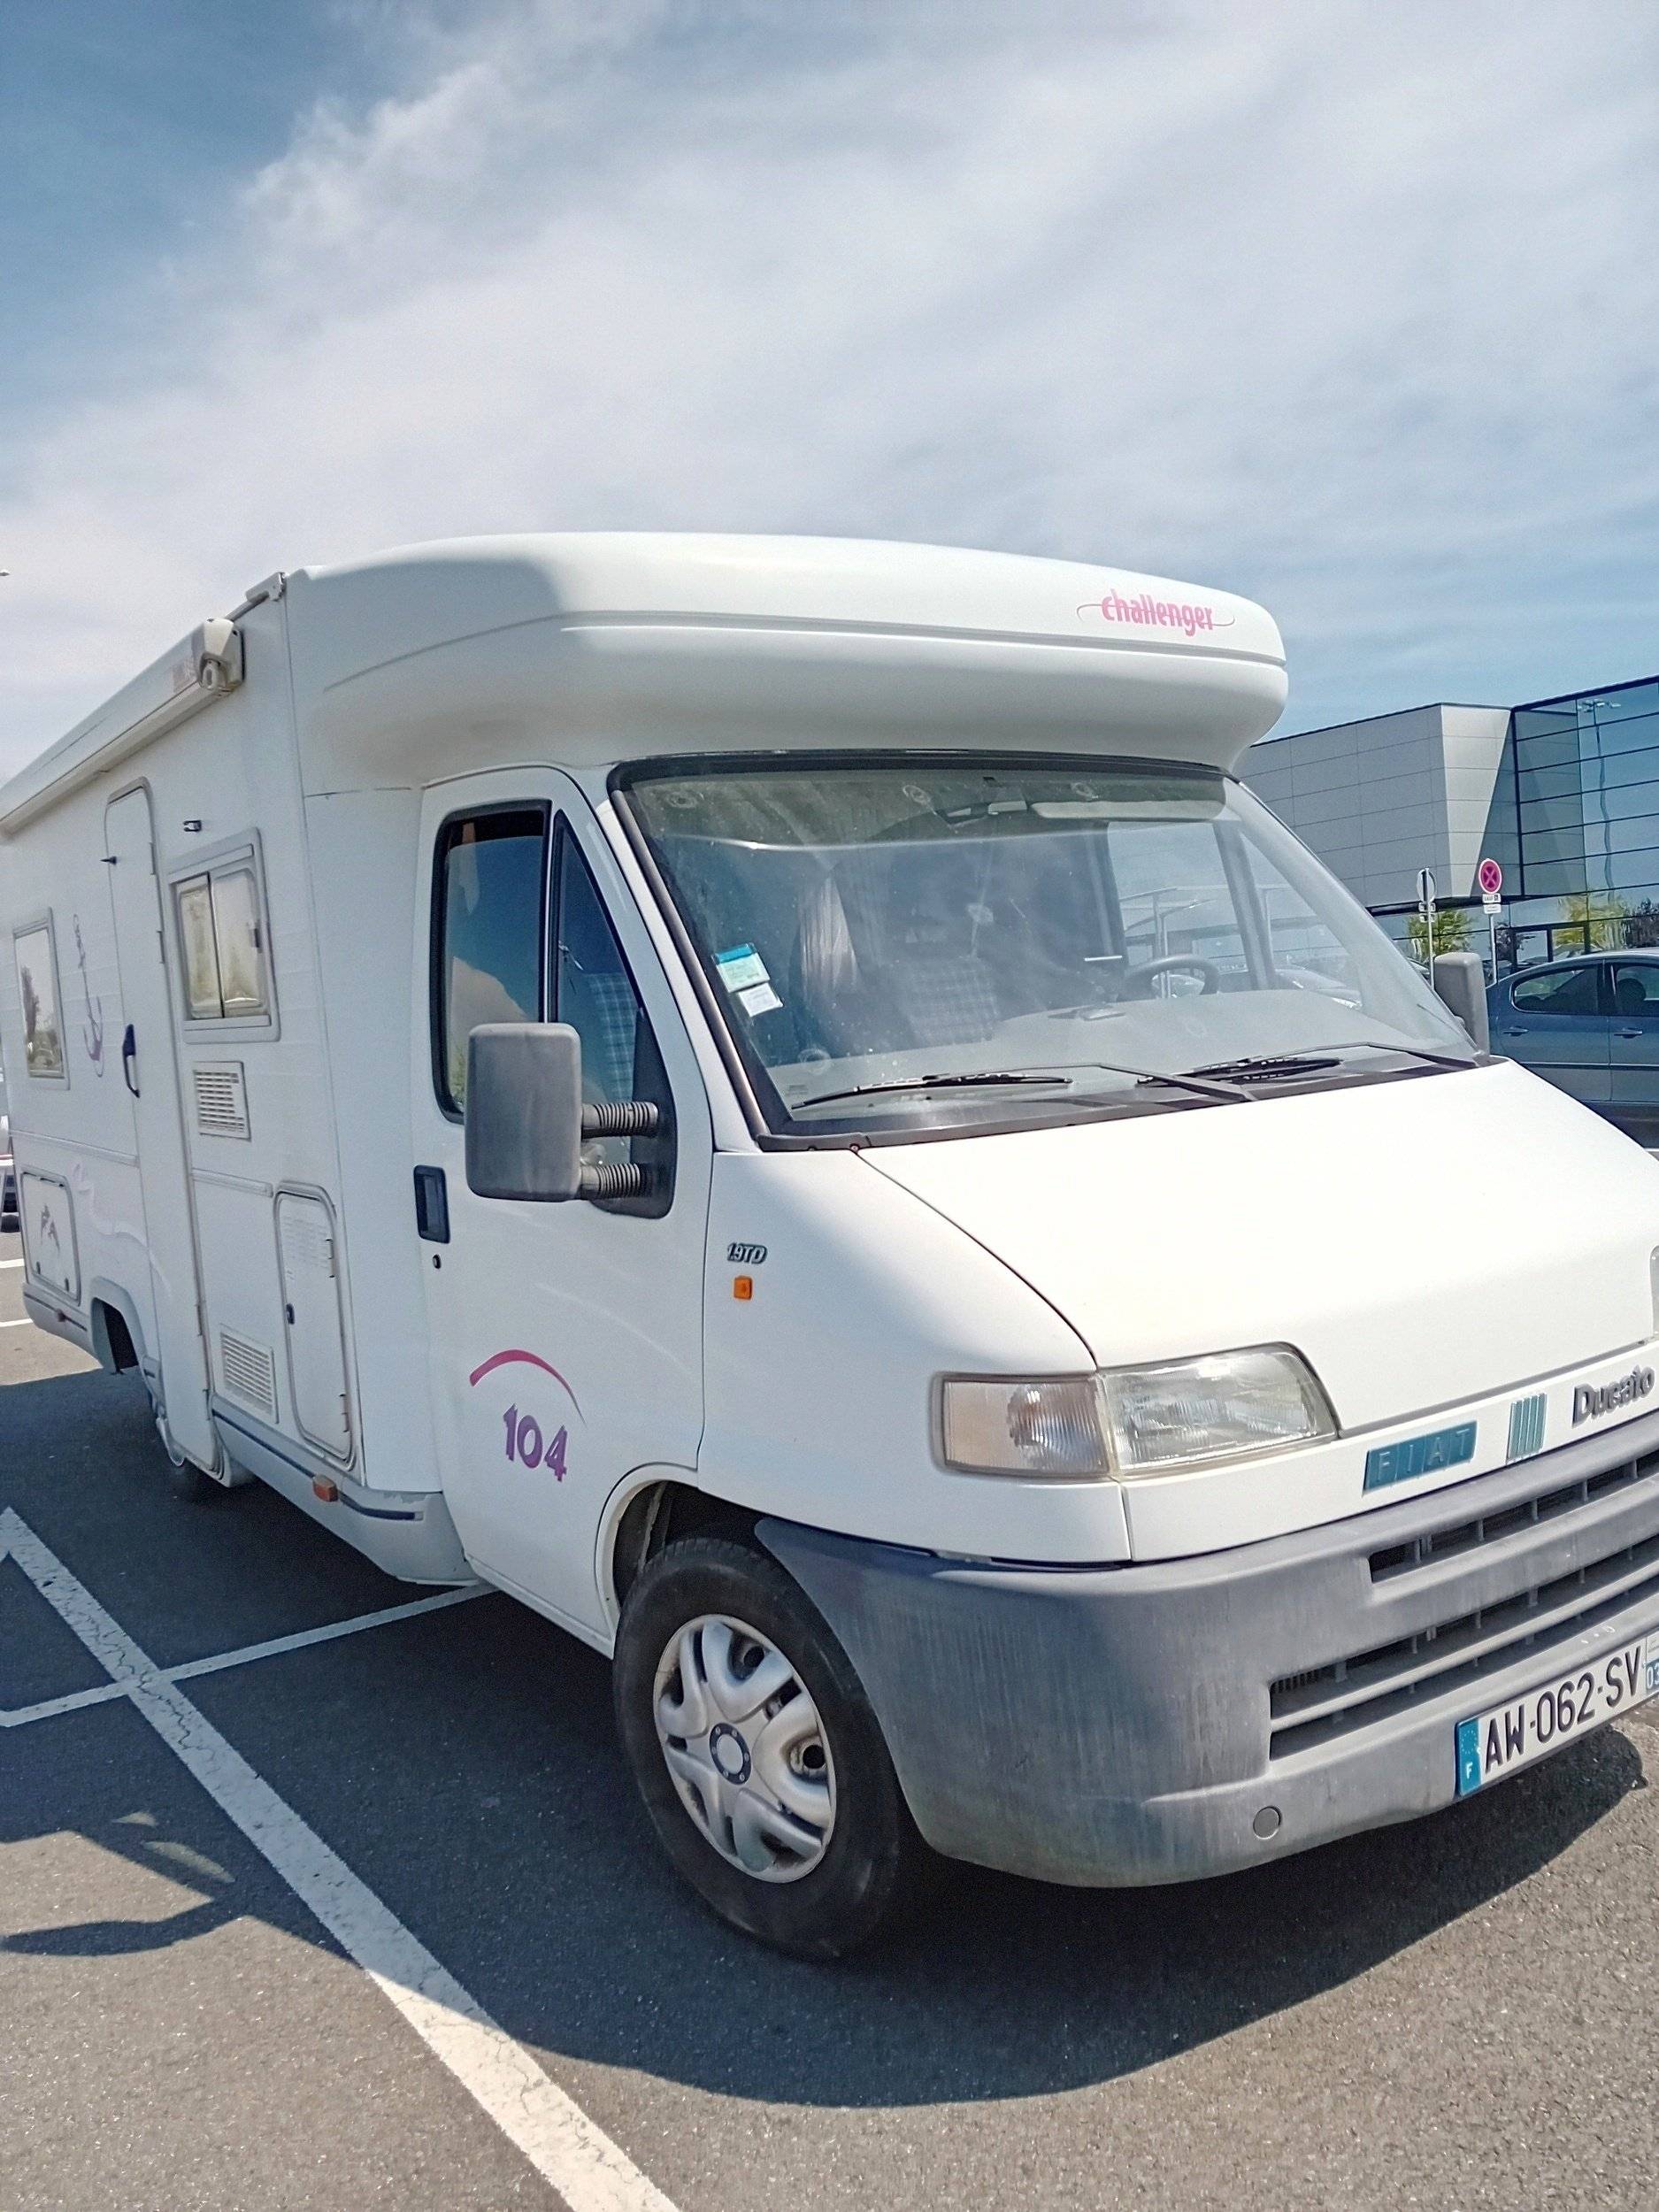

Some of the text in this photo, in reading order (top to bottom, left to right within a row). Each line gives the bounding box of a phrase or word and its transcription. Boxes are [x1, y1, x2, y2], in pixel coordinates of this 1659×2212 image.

[1101, 588, 1214, 637] challenger
[1572, 1364, 1655, 1428] Ducato
[503, 1402, 568, 1483] 104
[1376, 1426, 1471, 1483] FIAT
[1465, 1761, 1473, 1779] F
